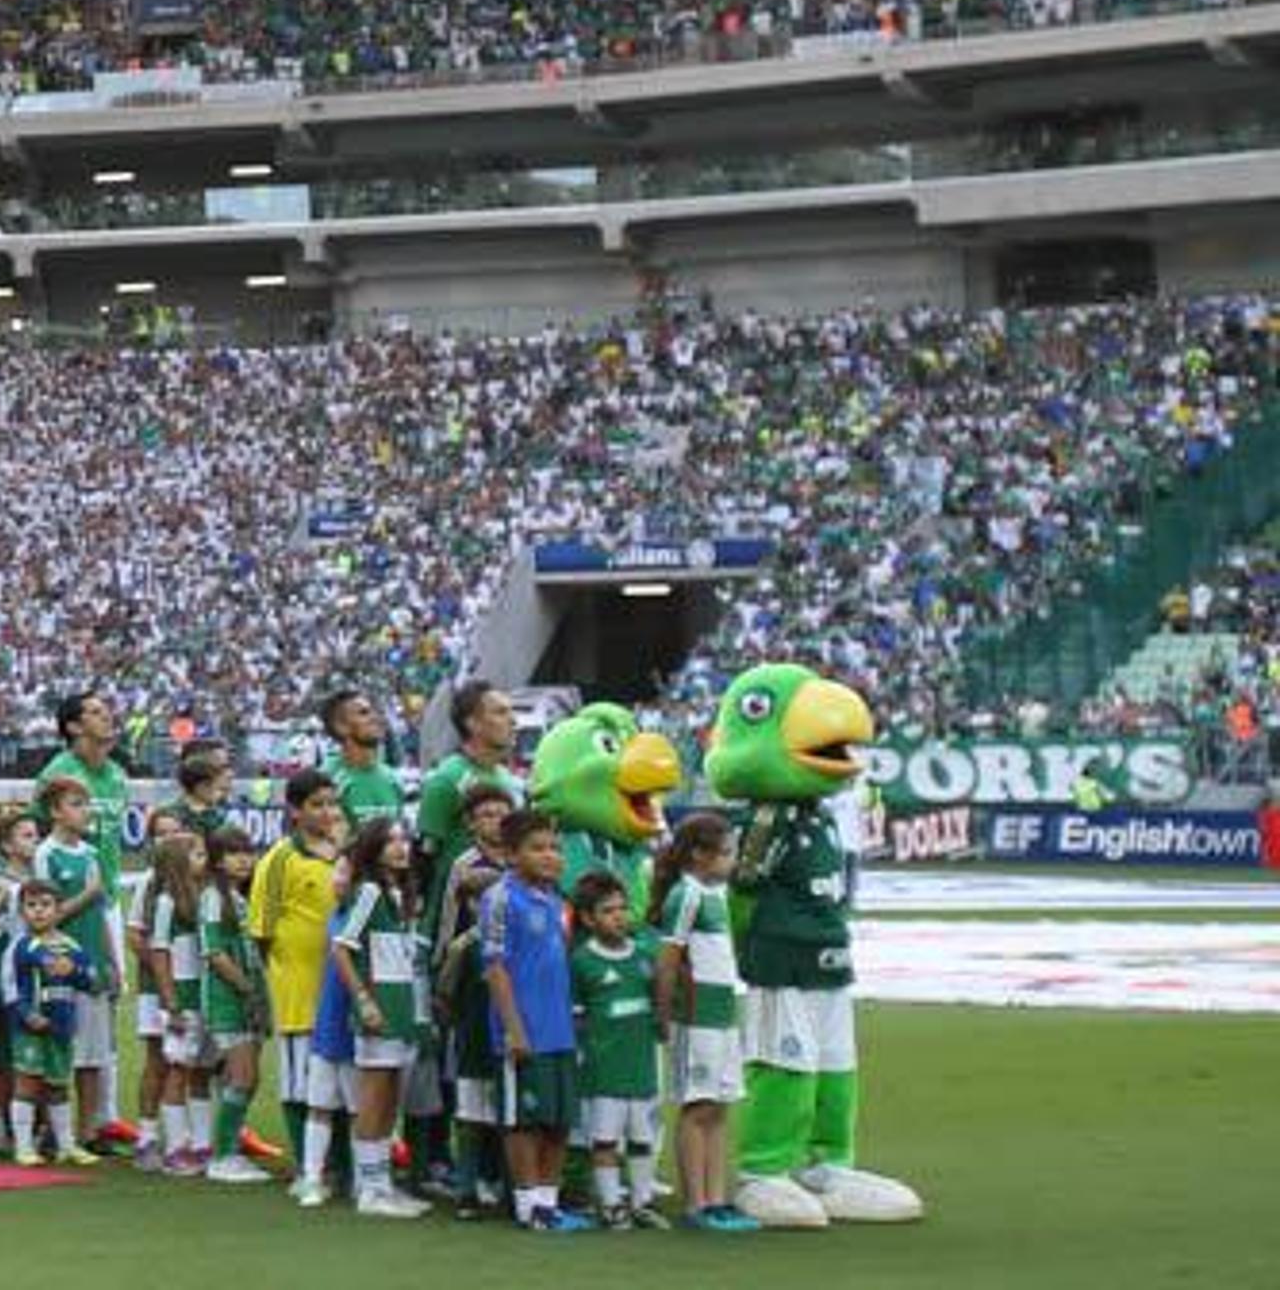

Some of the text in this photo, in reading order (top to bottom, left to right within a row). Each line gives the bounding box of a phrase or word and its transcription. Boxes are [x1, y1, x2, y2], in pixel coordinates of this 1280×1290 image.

[893, 807, 971, 860] DOLLY
[994, 814, 1262, 860] EF Englishtown
